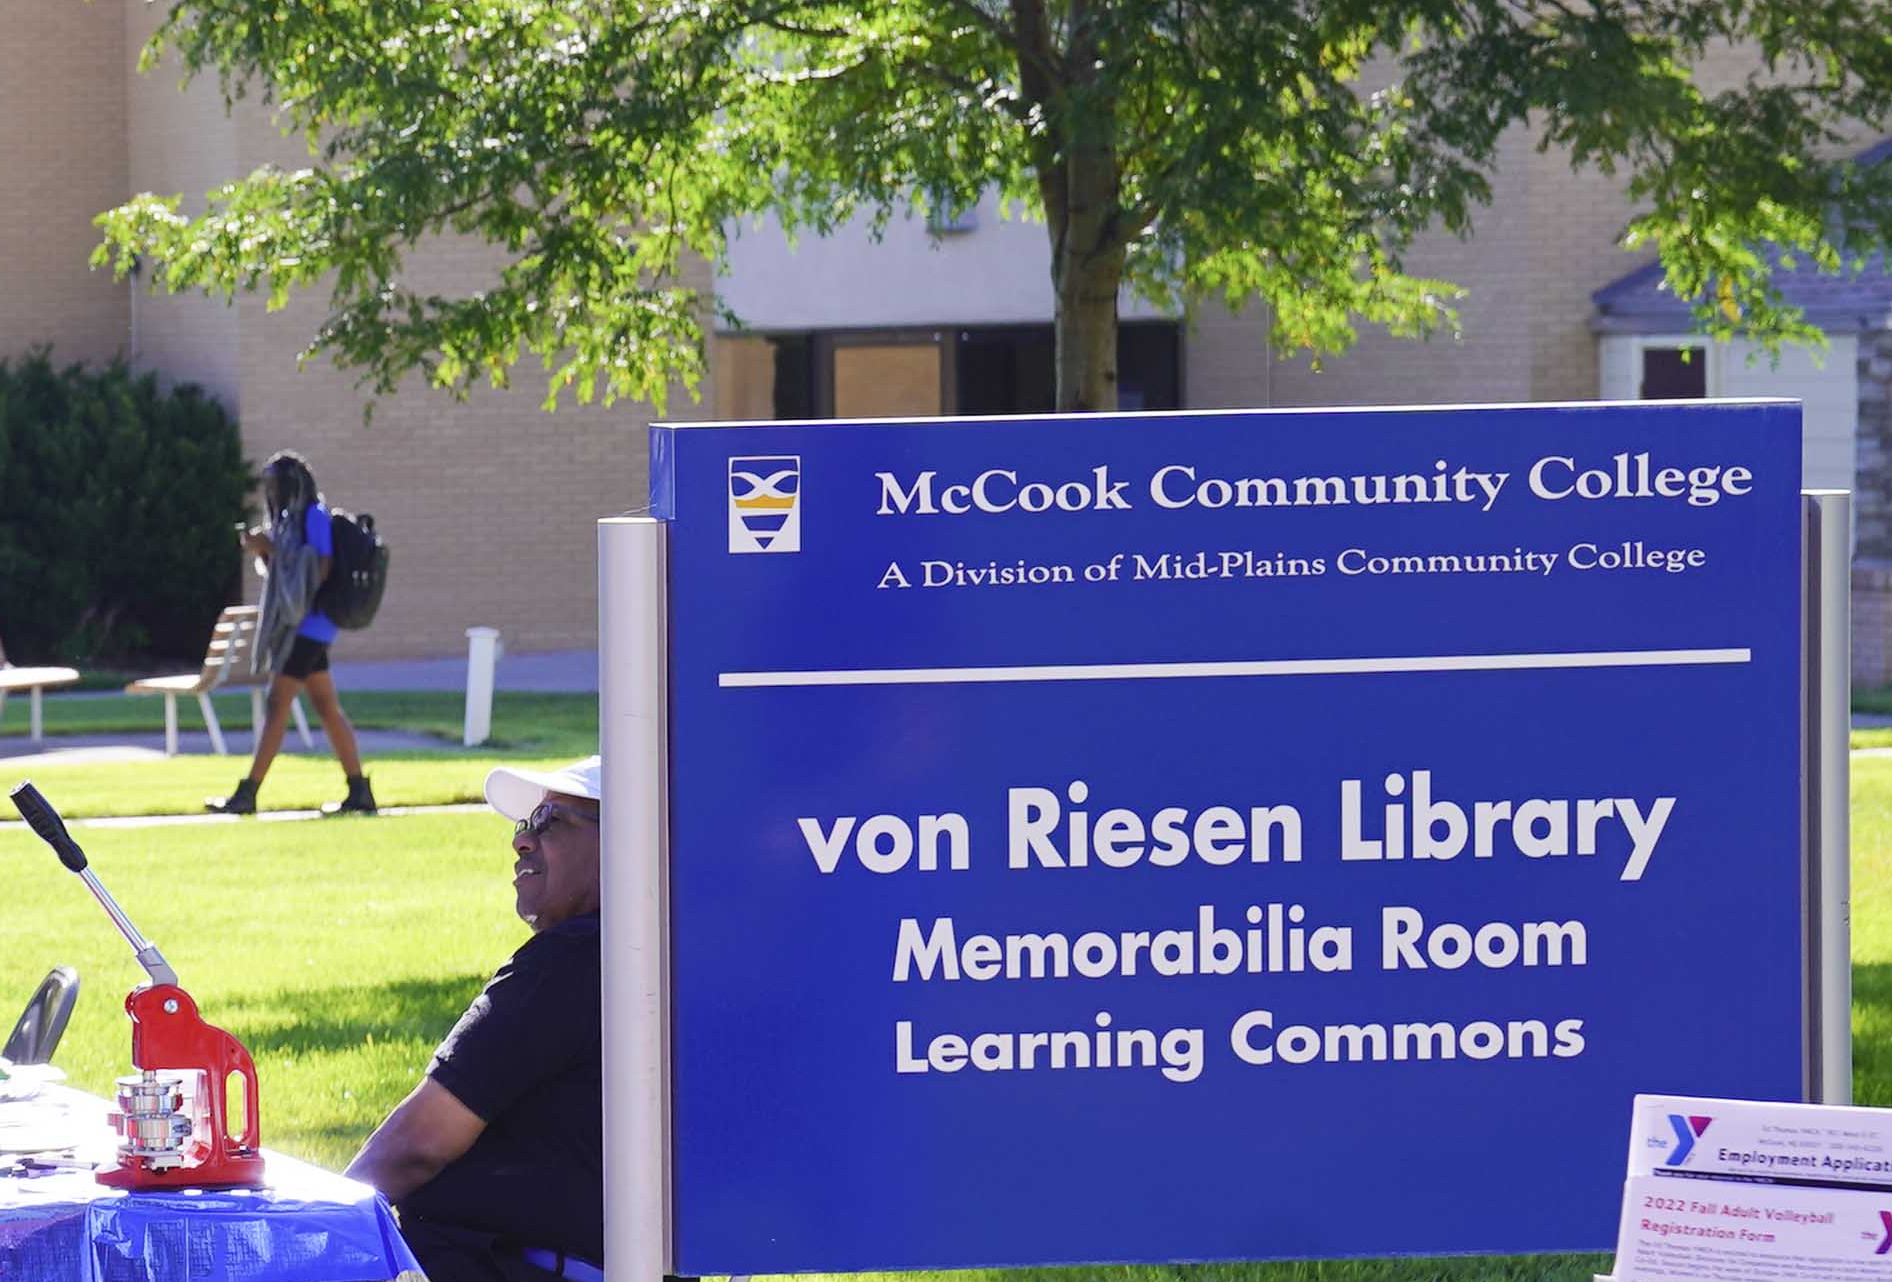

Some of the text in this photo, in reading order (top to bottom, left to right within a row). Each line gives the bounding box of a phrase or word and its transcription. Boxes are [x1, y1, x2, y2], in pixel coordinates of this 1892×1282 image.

[875, 452, 1753, 515] McCook Community College
[878, 541, 1706, 589] A Division of Mid-Plains Community College
[798, 770, 1677, 881] von Riesen Library
[892, 903, 1587, 982] Memorabilia Room
[896, 1010, 1585, 1083] Learning Commons
[1717, 1148, 1892, 1174] Employment Applicat
[1640, 1218, 1776, 1243] Registration Form
[1644, 1195, 1834, 1226] 2022 Fall Adult Volleyball
